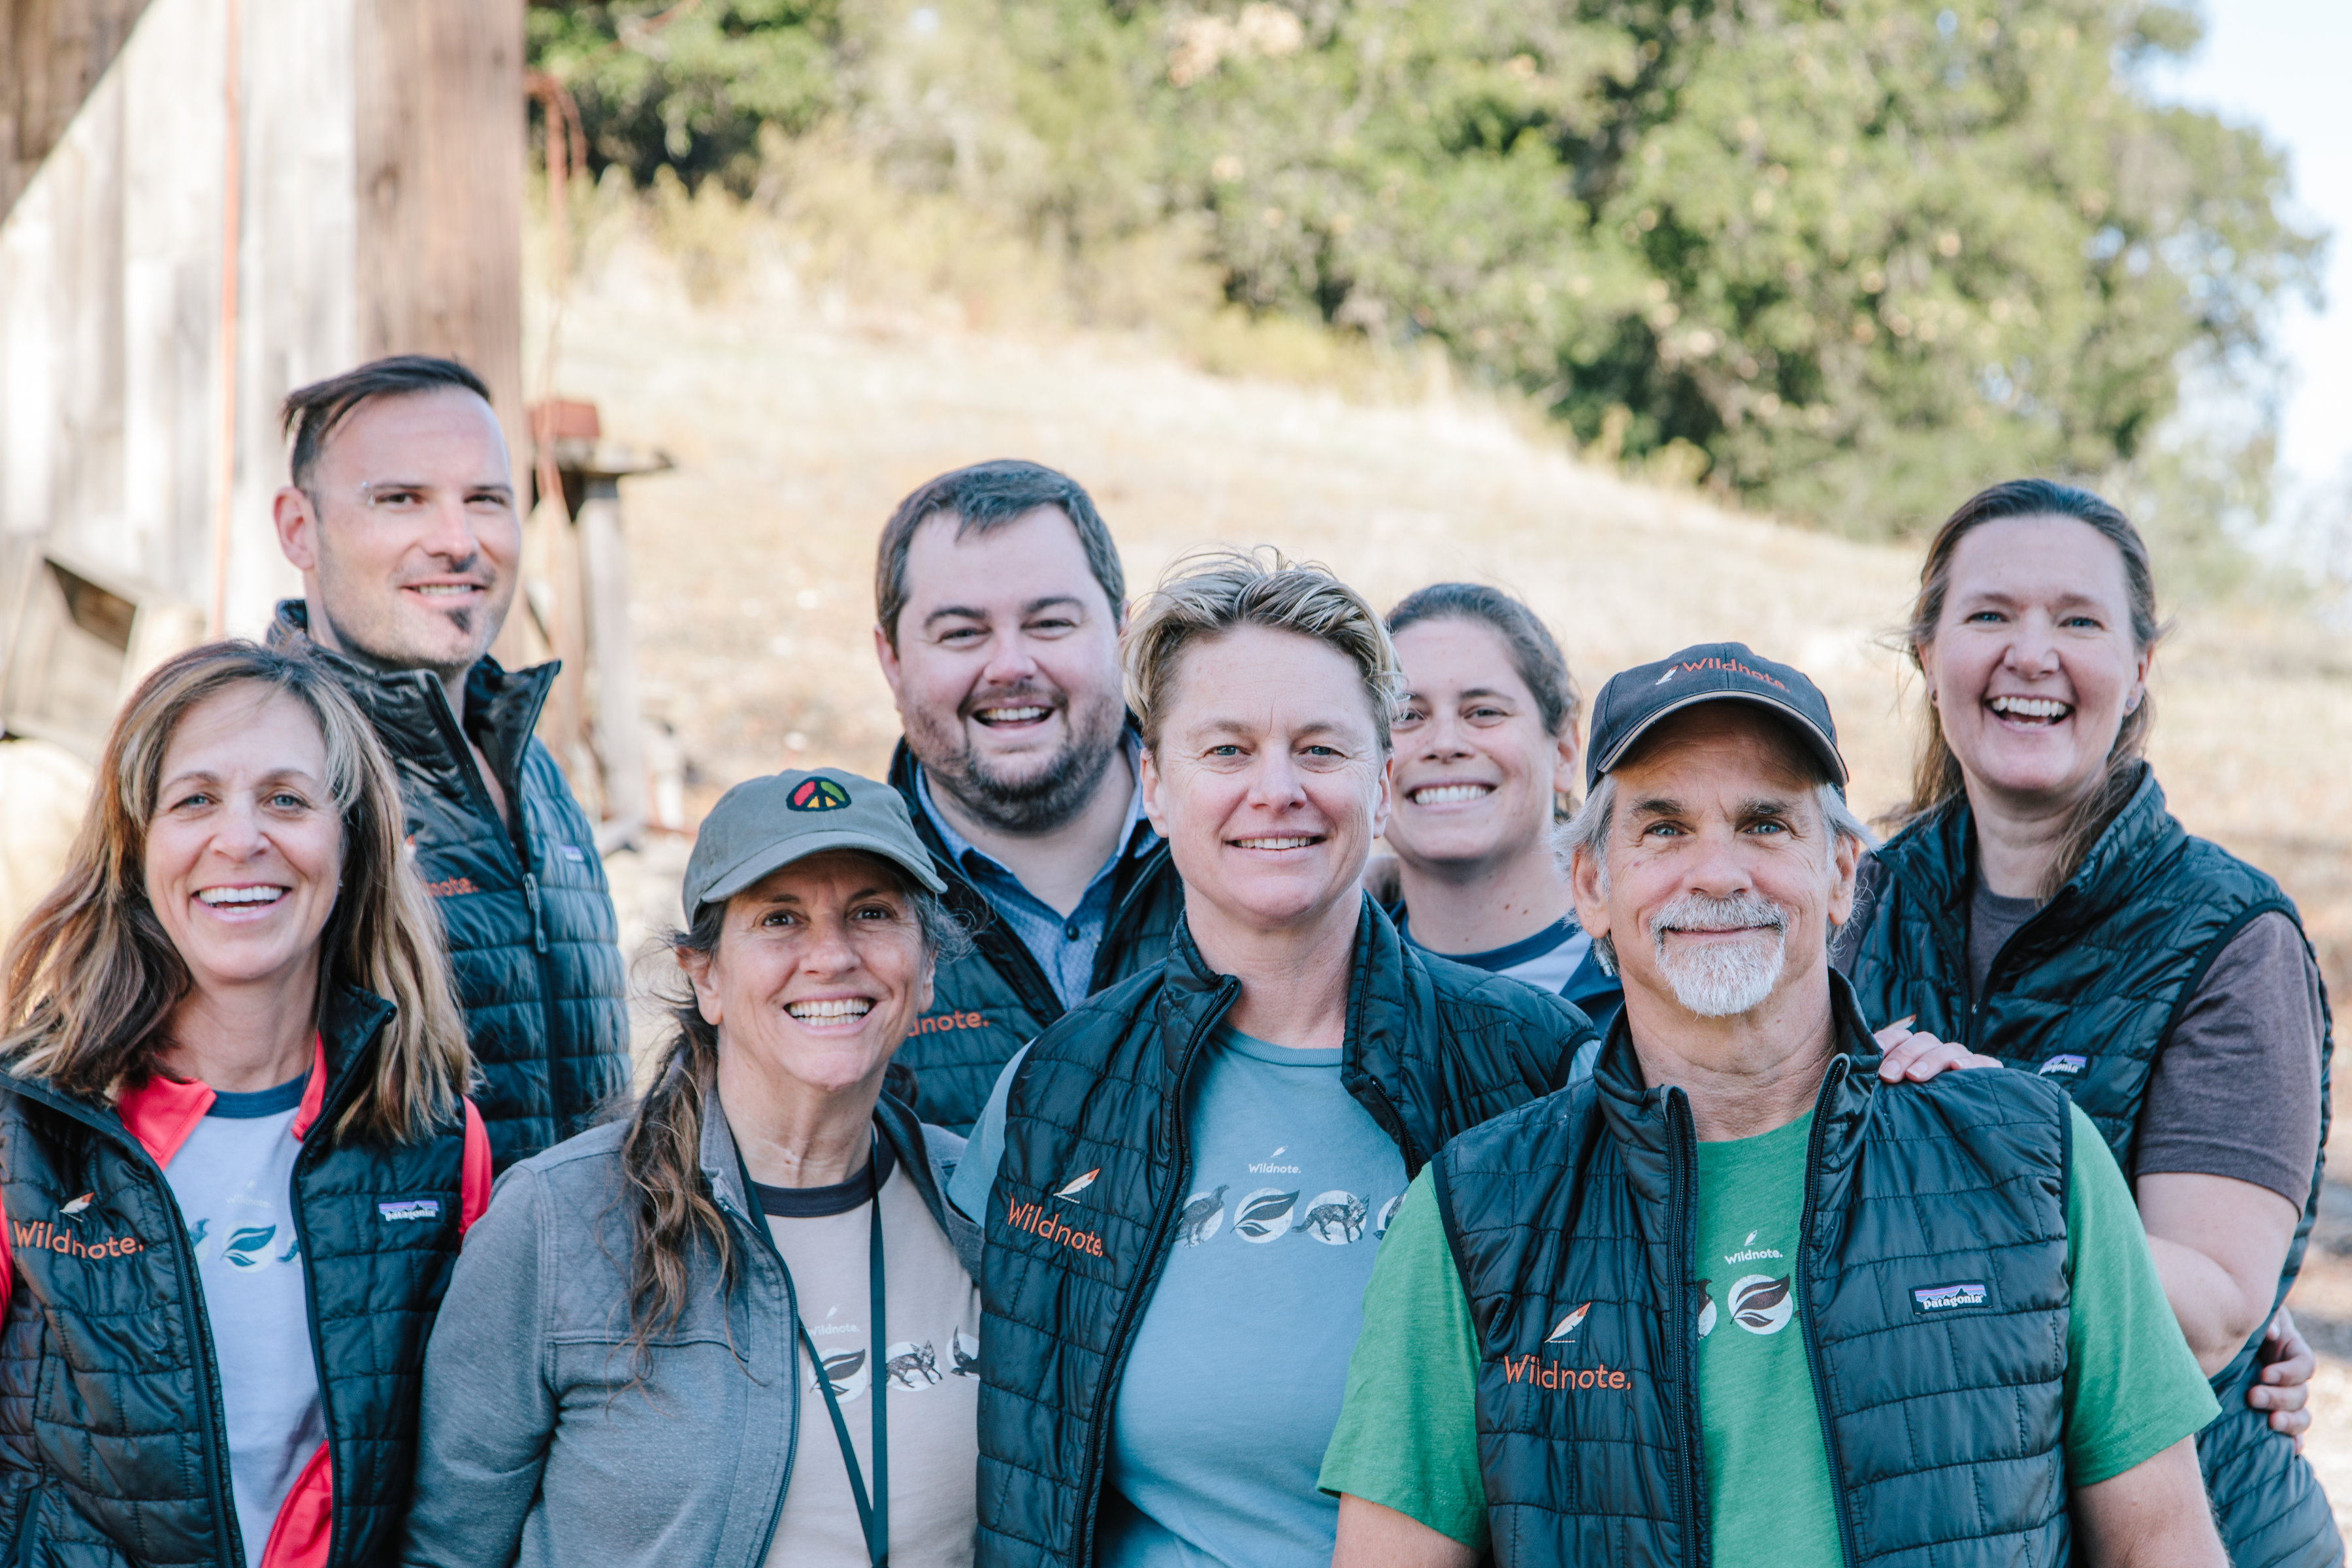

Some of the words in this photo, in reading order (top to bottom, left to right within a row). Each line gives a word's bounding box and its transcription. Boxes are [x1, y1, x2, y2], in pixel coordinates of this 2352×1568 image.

[1682, 657, 1790, 693] Wildnote.
[421, 875, 479, 897] note.
[1249, 1162, 1301, 1174] Wildnote.
[385, 1209, 436, 1222] patagonia
[13, 1220, 144, 1260] Wildnote.
[1724, 1249, 1784, 1265] Wildnote.
[1923, 1294, 1984, 1310] patagonia
[807, 1324, 860, 1337] Wildnote.
[1504, 1354, 1631, 1390] Wildnote.
